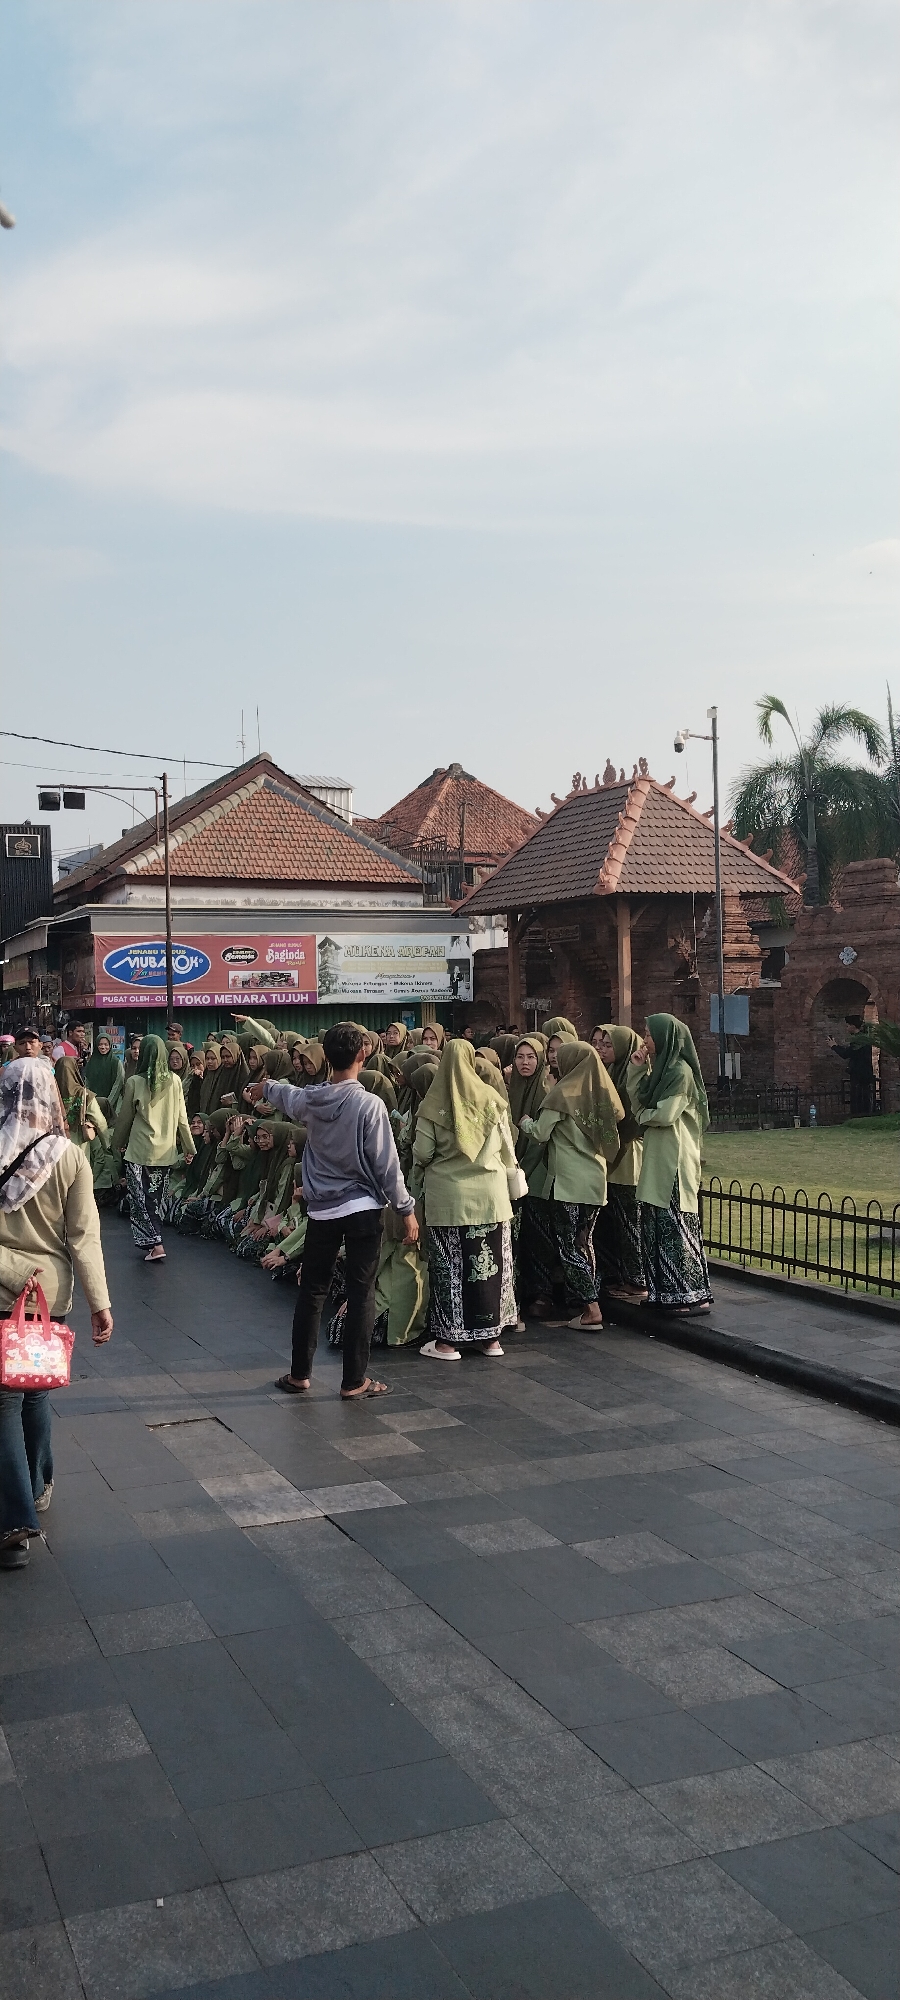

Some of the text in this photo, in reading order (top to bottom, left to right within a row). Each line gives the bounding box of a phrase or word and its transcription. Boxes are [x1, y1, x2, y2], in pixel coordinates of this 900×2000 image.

[266, 949, 305, 963] Baginda
[179, 993, 308, 1005] TOKO MENARA TUJUH
